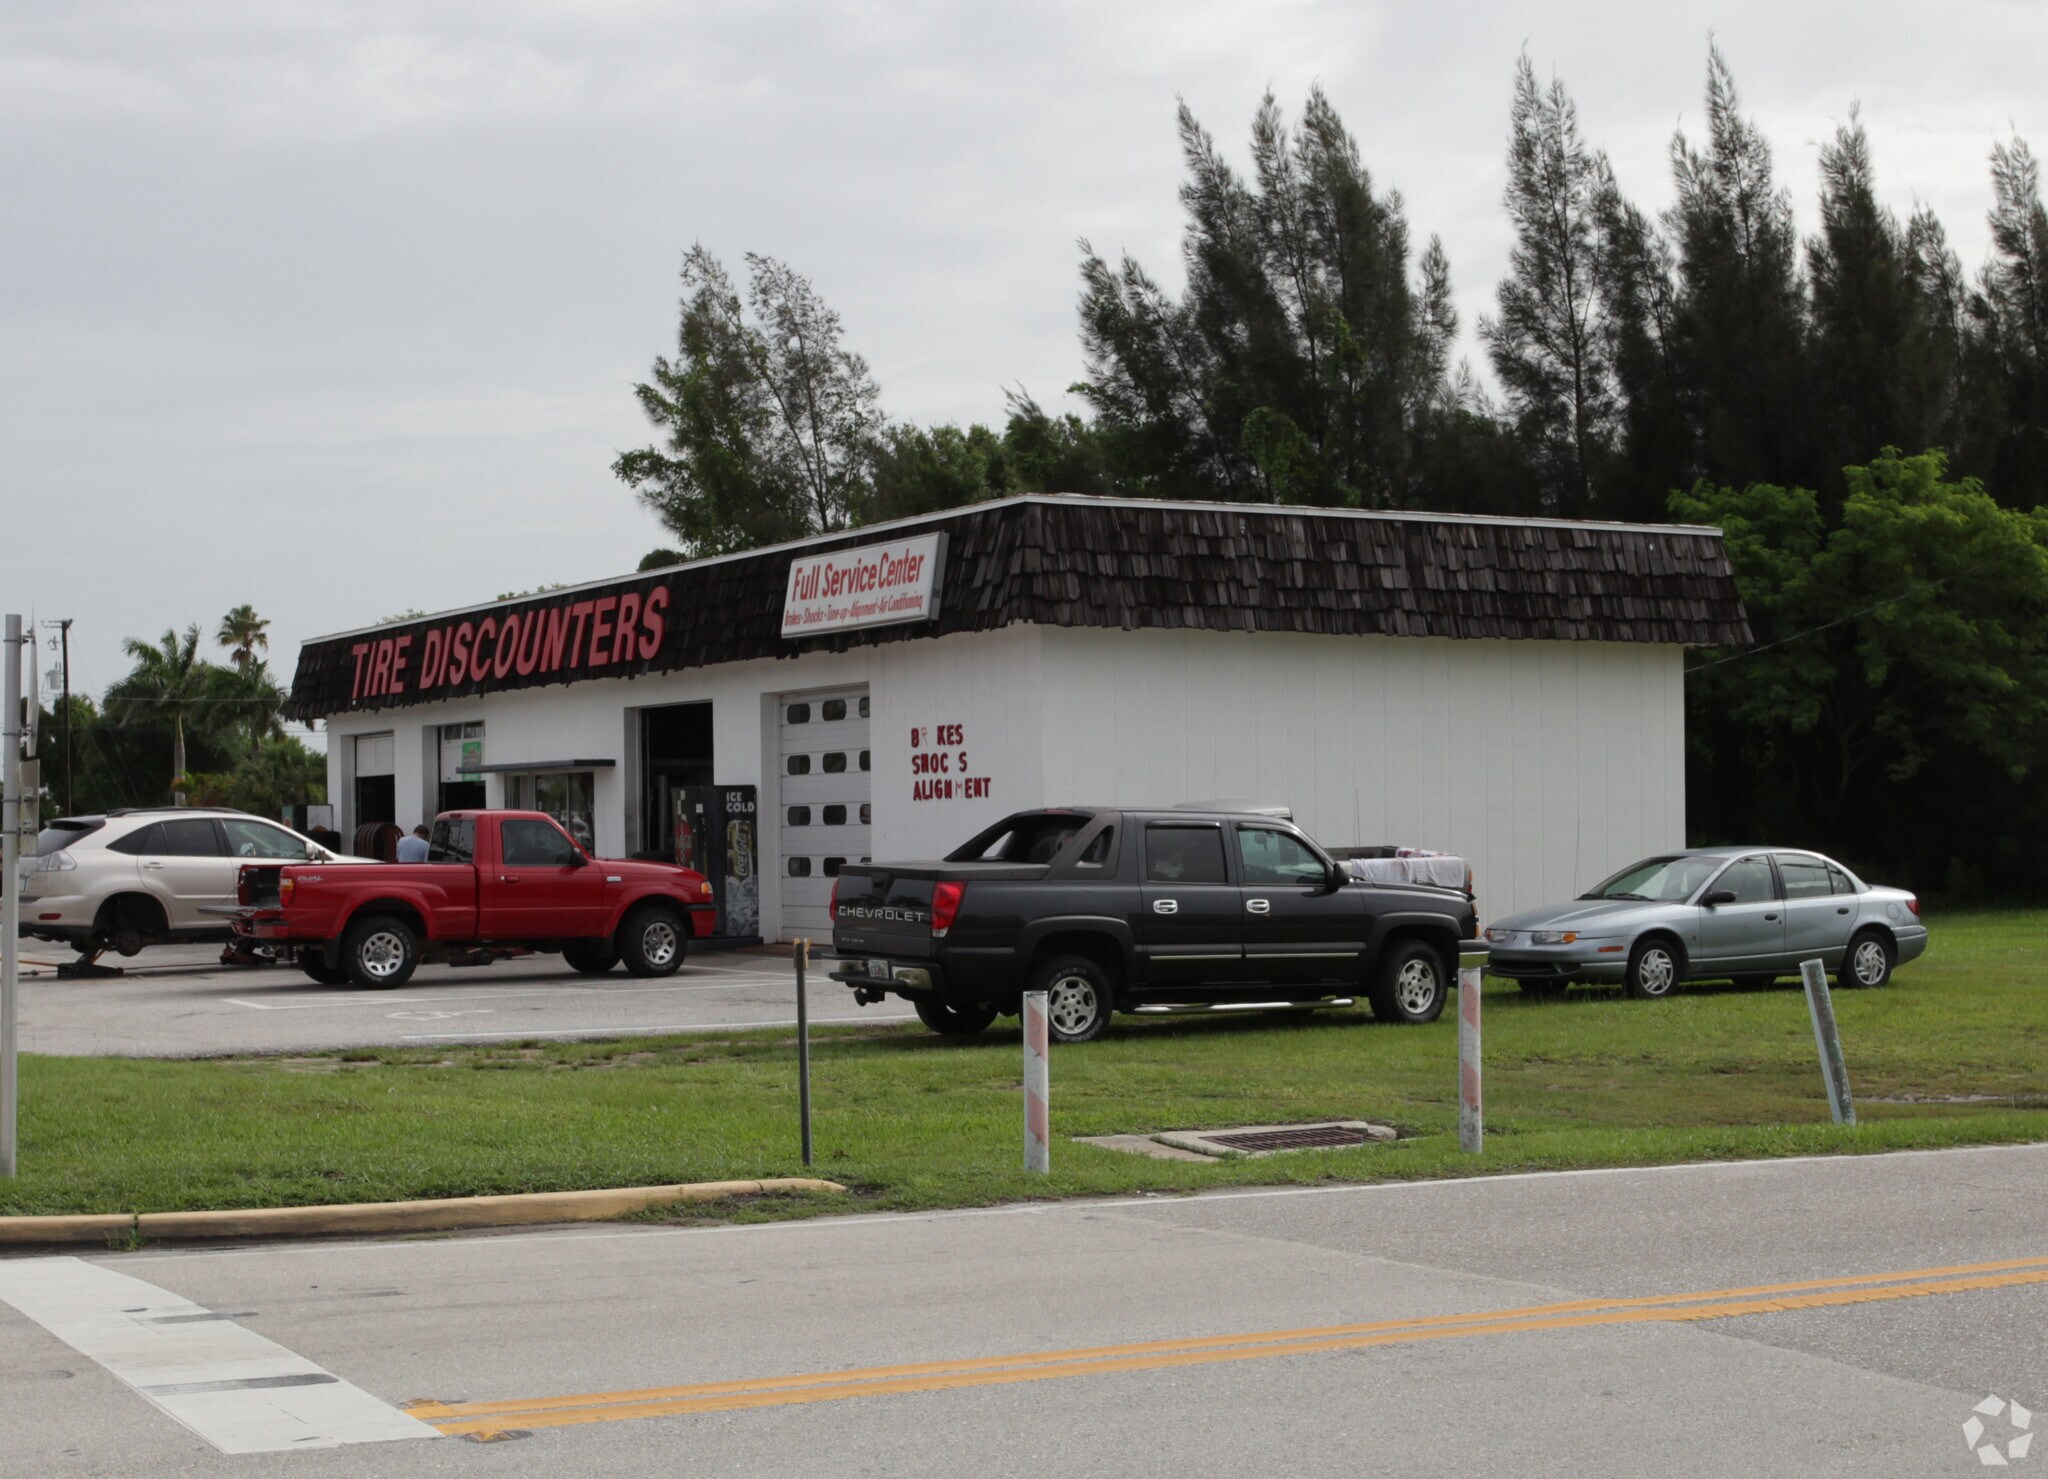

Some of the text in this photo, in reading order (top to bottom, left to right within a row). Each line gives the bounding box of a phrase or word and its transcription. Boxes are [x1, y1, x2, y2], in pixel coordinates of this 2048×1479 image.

[792, 548, 925, 602] Full Service Center
[803, 605, 824, 624] Shocks
[850, 600, 878, 620] Alignment
[888, 591, 923, 612] Conditioning
[351, 585, 671, 699] TIRE DISCOUNTERS
[912, 751, 967, 775] SHOCS
[726, 791, 742, 802] ICE
[726, 802, 755, 813] COLD
[838, 905, 924, 922] CHEVROLET
